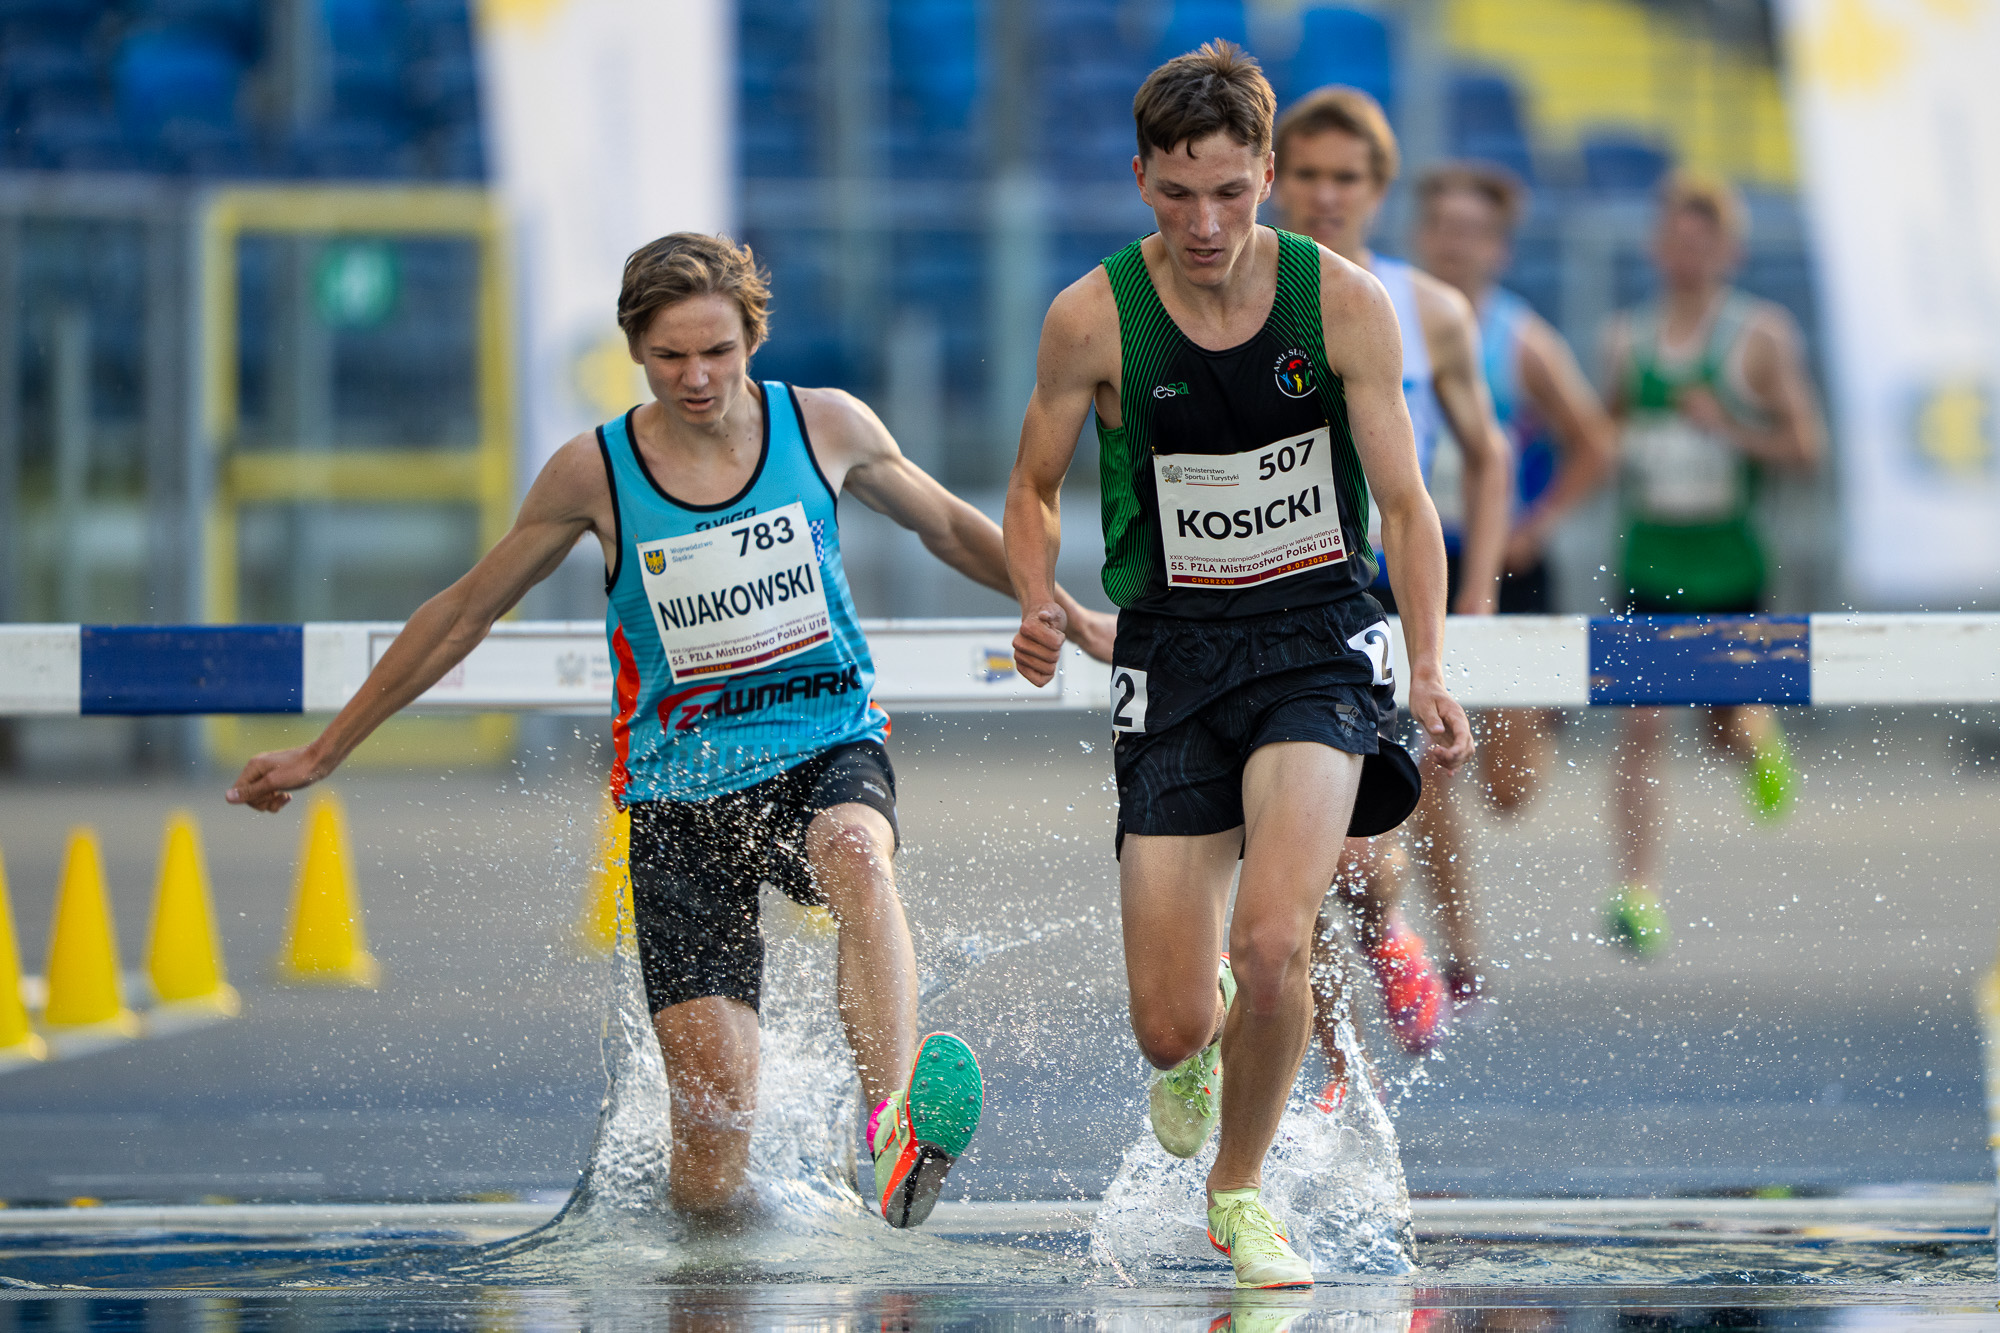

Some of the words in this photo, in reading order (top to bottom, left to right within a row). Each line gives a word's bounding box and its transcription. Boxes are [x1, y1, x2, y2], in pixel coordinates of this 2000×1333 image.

[1184, 466, 1225, 474] Ministerstwo
[1259, 438, 1315, 481] 507
[1177, 485, 1322, 540] KOSICKI
[731, 516, 795, 557] 783
[1171, 562, 1187, 571] 55.
[1190, 563, 1217, 573] PZLA
[1220, 554, 1283, 573] Mistrzostwa
[1286, 541, 1317, 559] Polski
[1319, 535, 1341, 549] U18
[1184, 555, 1226, 563] Ogólnopolska
[1227, 553, 1260, 563] Olimpiada
[1295, 534, 1313, 544] lekkiej
[1314, 528, 1339, 538] atletyce
[1191, 577, 1235, 585] CHORZÓW
[1277, 555, 1328, 574] 7-9.07.2022
[658, 563, 815, 631] NIJAKOWSKI
[672, 655, 687, 666] 55.
[689, 651, 714, 662] PZLA
[716, 636, 775, 658] Mistrzostwa
[777, 624, 807, 641] Polski
[809, 616, 827, 630] U18
[1364, 629, 1392, 681] 2
[1113, 672, 1135, 728] 2
